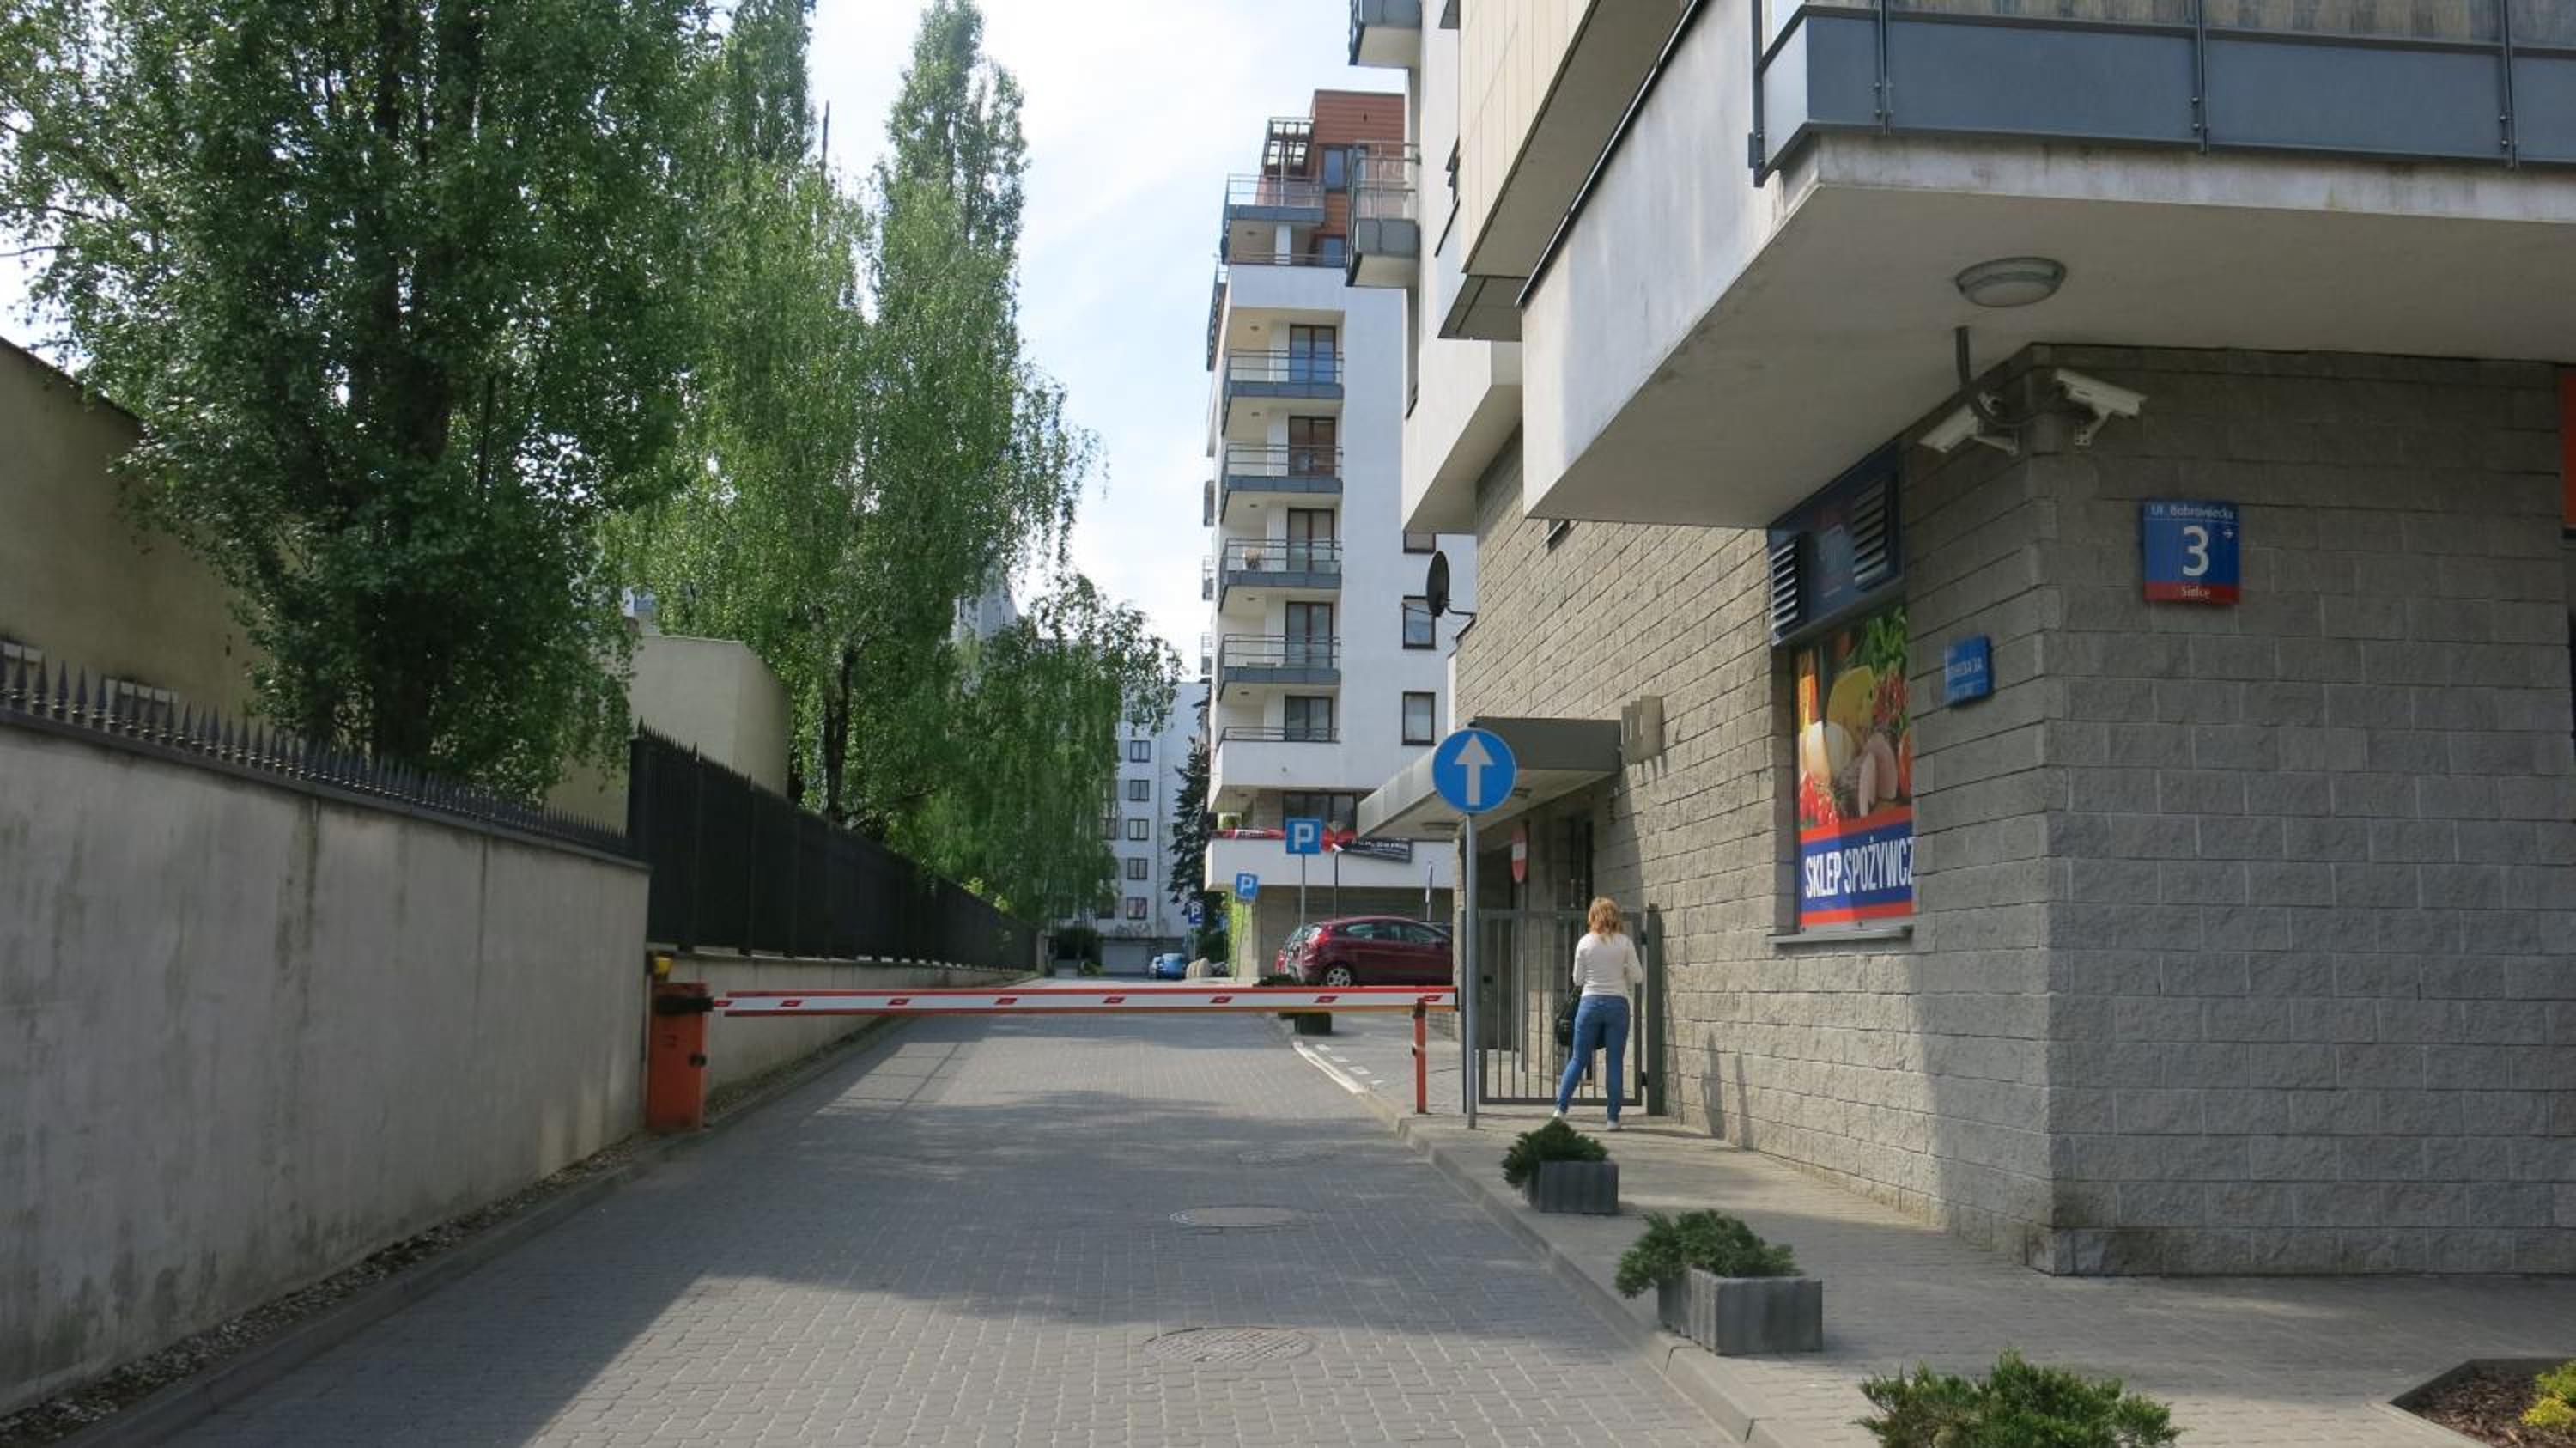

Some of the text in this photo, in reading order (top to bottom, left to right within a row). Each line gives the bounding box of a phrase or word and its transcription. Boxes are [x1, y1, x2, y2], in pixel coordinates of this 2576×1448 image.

[2182, 525, 2209, 576] 3
[1294, 823, 1314, 851] P
[1240, 875, 1254, 894] P
[1806, 852, 1842, 898] SKLEP
